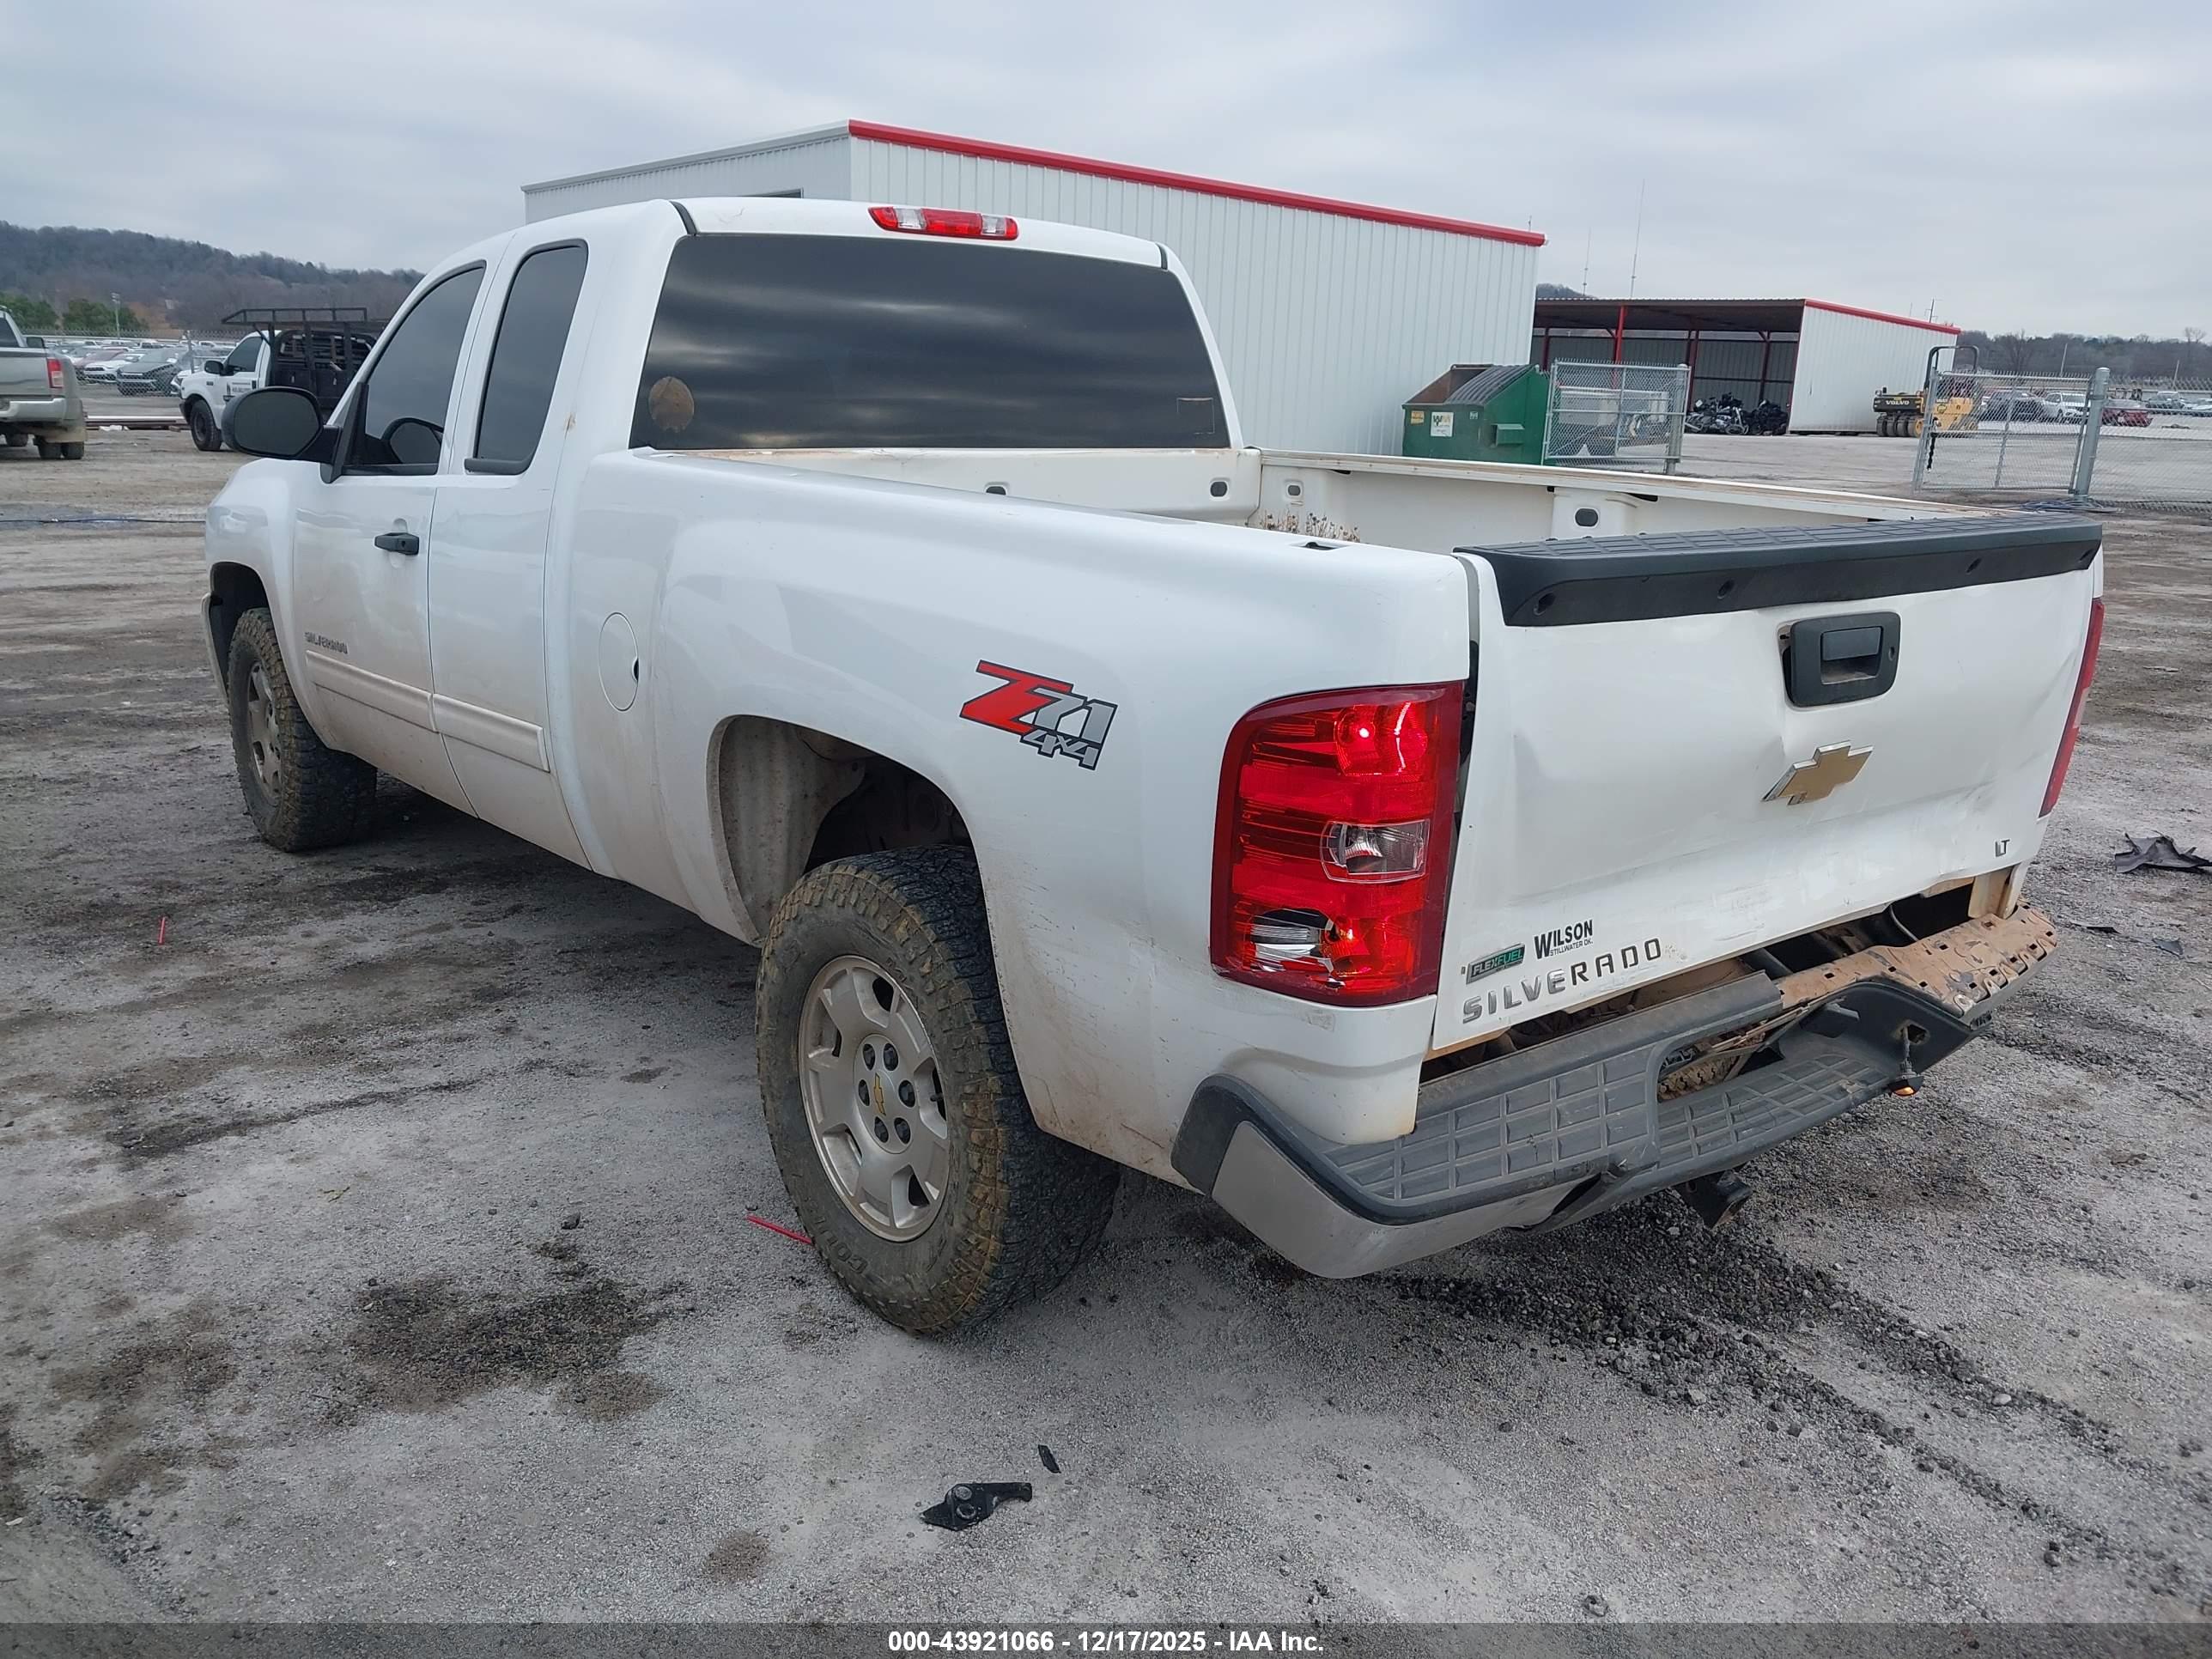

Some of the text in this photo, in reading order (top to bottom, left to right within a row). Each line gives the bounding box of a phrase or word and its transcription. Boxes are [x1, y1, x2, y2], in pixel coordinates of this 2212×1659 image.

[959, 659, 1118, 747] Z71
[1995, 839, 2010, 857] LT
[1534, 920, 1593, 959] WILSON
[1549, 940, 1585, 956] STILLWATER
[1472, 949, 1523, 975] FLEXFUEL
[1462, 938, 1662, 1024] SILVERADO
